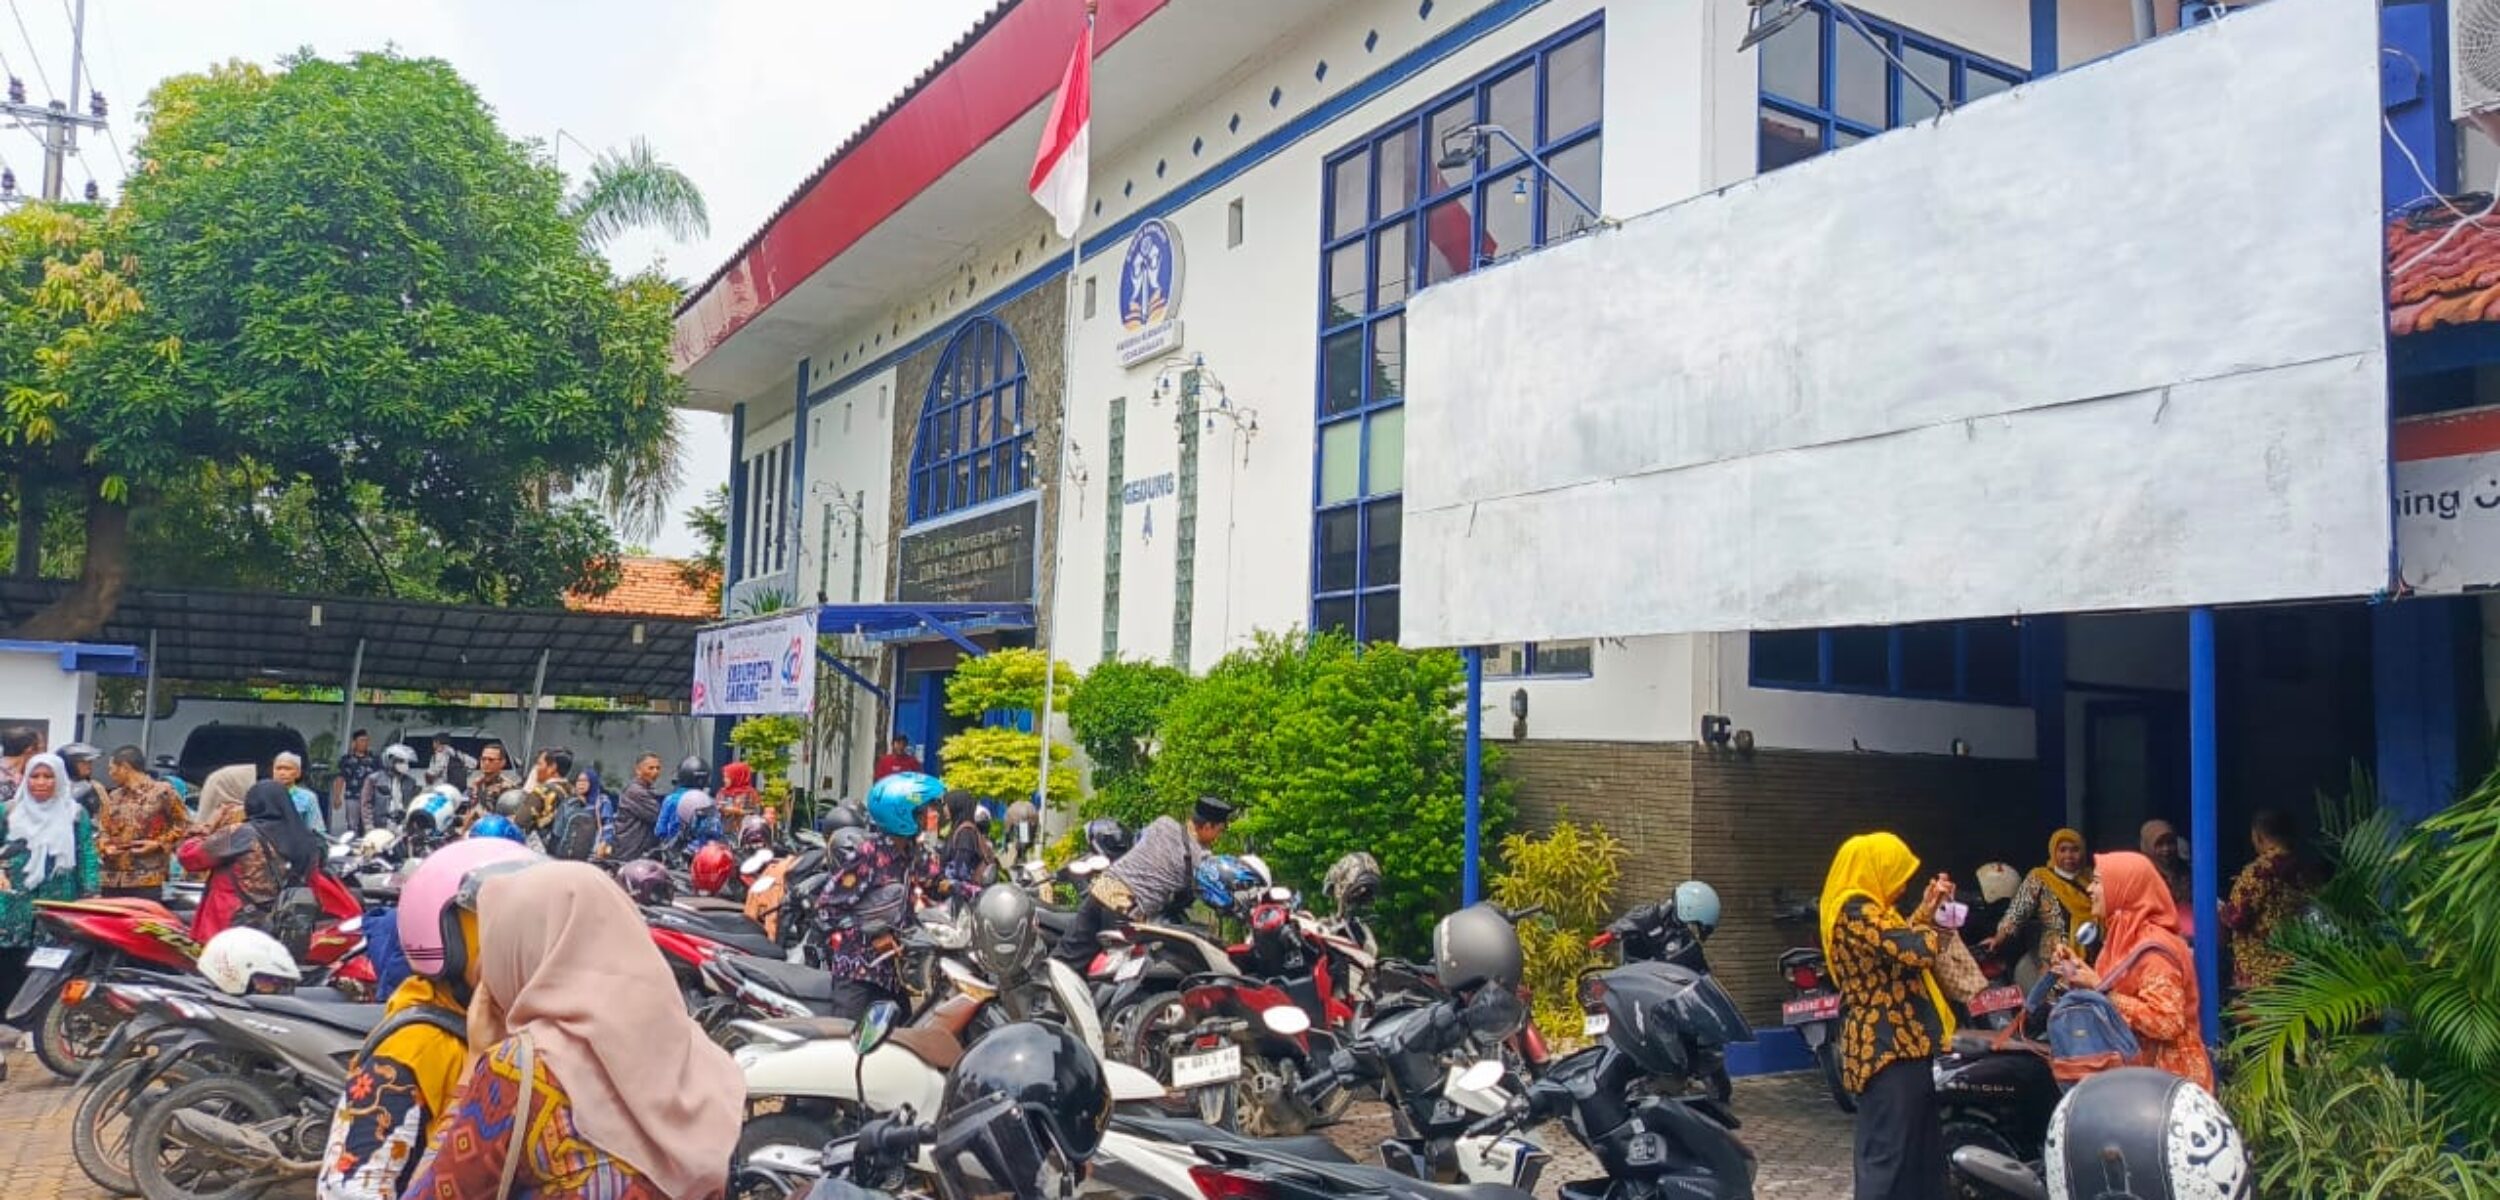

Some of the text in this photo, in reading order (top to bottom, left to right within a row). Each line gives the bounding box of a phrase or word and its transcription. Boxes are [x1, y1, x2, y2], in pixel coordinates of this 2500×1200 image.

[1123, 472, 1175, 504] GEDUNG
[2396, 489, 2460, 519] ing
[1141, 504, 1153, 540] A
